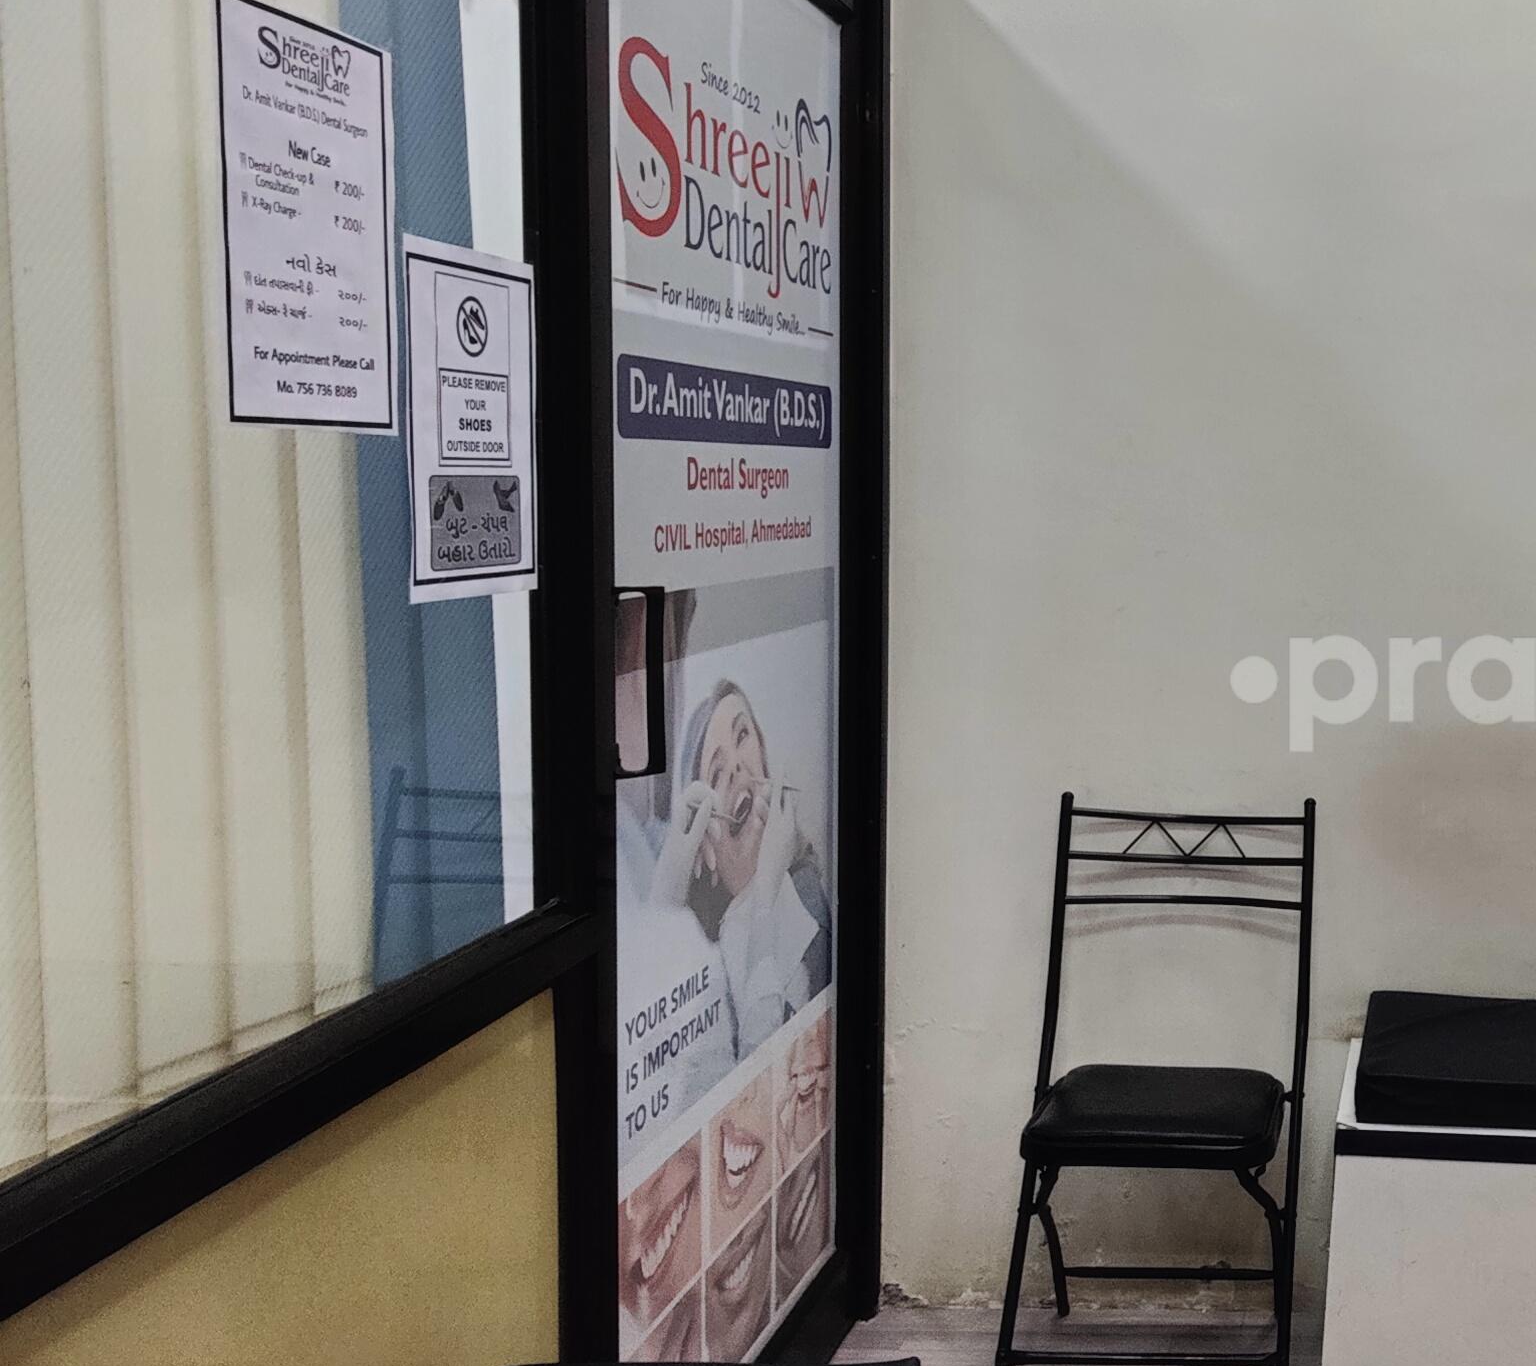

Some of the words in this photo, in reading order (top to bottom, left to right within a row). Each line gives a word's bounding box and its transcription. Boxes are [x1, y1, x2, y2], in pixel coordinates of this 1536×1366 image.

[281, 57, 320, 87] Dental
[324, 73, 350, 97] Care
[700, 62, 729, 96] Since
[733, 83, 761, 114] 2012
[288, 139, 309, 161] New
[310, 146, 331, 168] Case
[248, 156, 272, 174] Dental
[273, 163, 307, 184] Check-up
[615, 36, 791, 299] Shreeji
[255, 174, 299, 196] Consultation
[251, 195, 272, 215] X-Ray
[273, 201, 297, 219] Charge
[684, 175, 773, 275] Dental
[783, 218, 831, 295] Care
[286, 253, 311, 273] નવો
[315, 256, 337, 278] કેસ
[337, 289, 367, 305] ૨૦૦/-
[662, 281, 682, 305] For
[686, 288, 720, 323] Happy
[725, 298, 734, 319] &
[738, 303, 773, 335] Healthy
[338, 316, 368, 331] ૨૦૦/-
[253, 346, 269, 360] For
[271, 348, 330, 367] Appointment
[332, 355, 358, 369] Please
[359, 357, 375, 371] Call
[296, 381, 314, 396] 756
[316, 383, 332, 397] 736
[335, 384, 358, 399] 8089
[442, 375, 473, 389] PLEASE
[475, 379, 506, 393] REMOVE
[464, 399, 486, 411] YOUR
[629, 367, 661, 416] Dr.
[662, 372, 711, 420] Amit
[713, 379, 770, 425] Vankar
[774, 387, 825, 441] (B.D.S.)
[459, 417, 492, 432] SHOES
[447, 440, 480, 452] OUTSIDE
[482, 442, 505, 453] DOOR
[687, 456, 735, 491] Dental
[738, 458, 789, 499] Surgeon
[446, 517, 468, 539] બુટ
[654, 524, 692, 553] CIVIL
[695, 519, 749, 553] Hospital,
[751, 515, 812, 544] Ahmedabad
[438, 545, 475, 563] બહાર
[625, 996, 667, 1046] YOUR
[671, 965, 710, 1014] SMILE
[626, 1062, 638, 1094] IS
[643, 998, 721, 1081] IMPORTANT
[625, 1103, 647, 1139] TO
[651, 1083, 669, 1119] US
